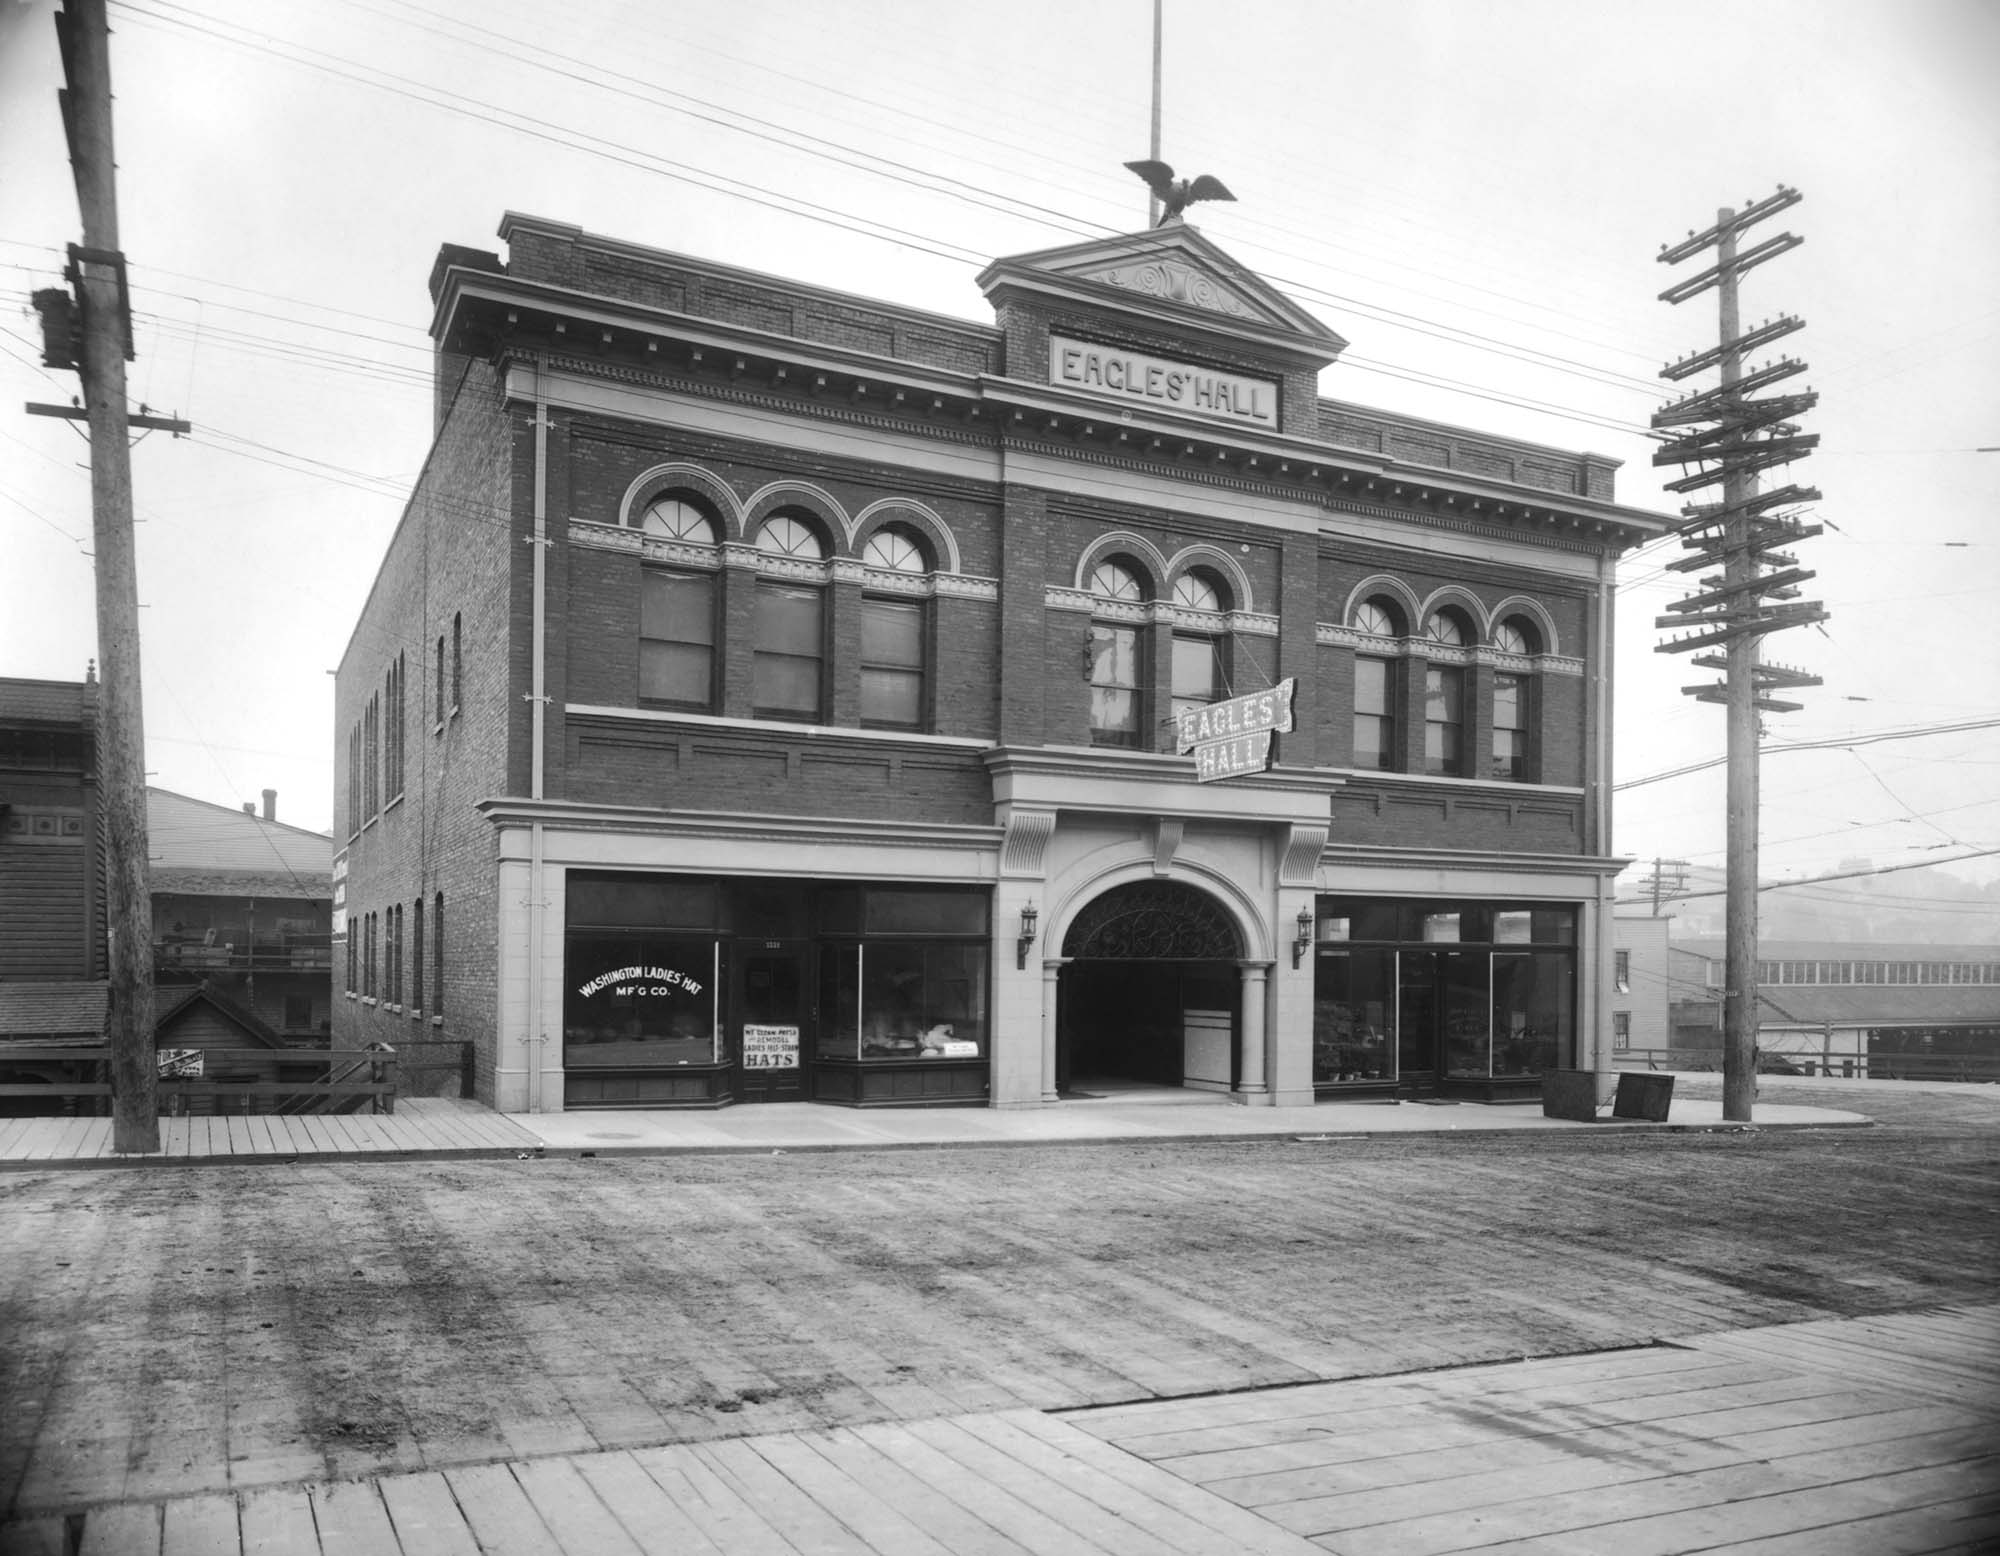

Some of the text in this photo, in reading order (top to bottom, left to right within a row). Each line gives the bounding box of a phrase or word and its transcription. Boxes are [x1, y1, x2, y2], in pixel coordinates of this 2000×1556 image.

[1062, 348, 1269, 420] EAGLES' HALL
[1201, 739, 1260, 777] HALL
[578, 966, 703, 998] WASHINGTON LADIES' HAT
[616, 985, 671, 996] MF'G CO.
[745, 1053, 793, 1067] HATS
